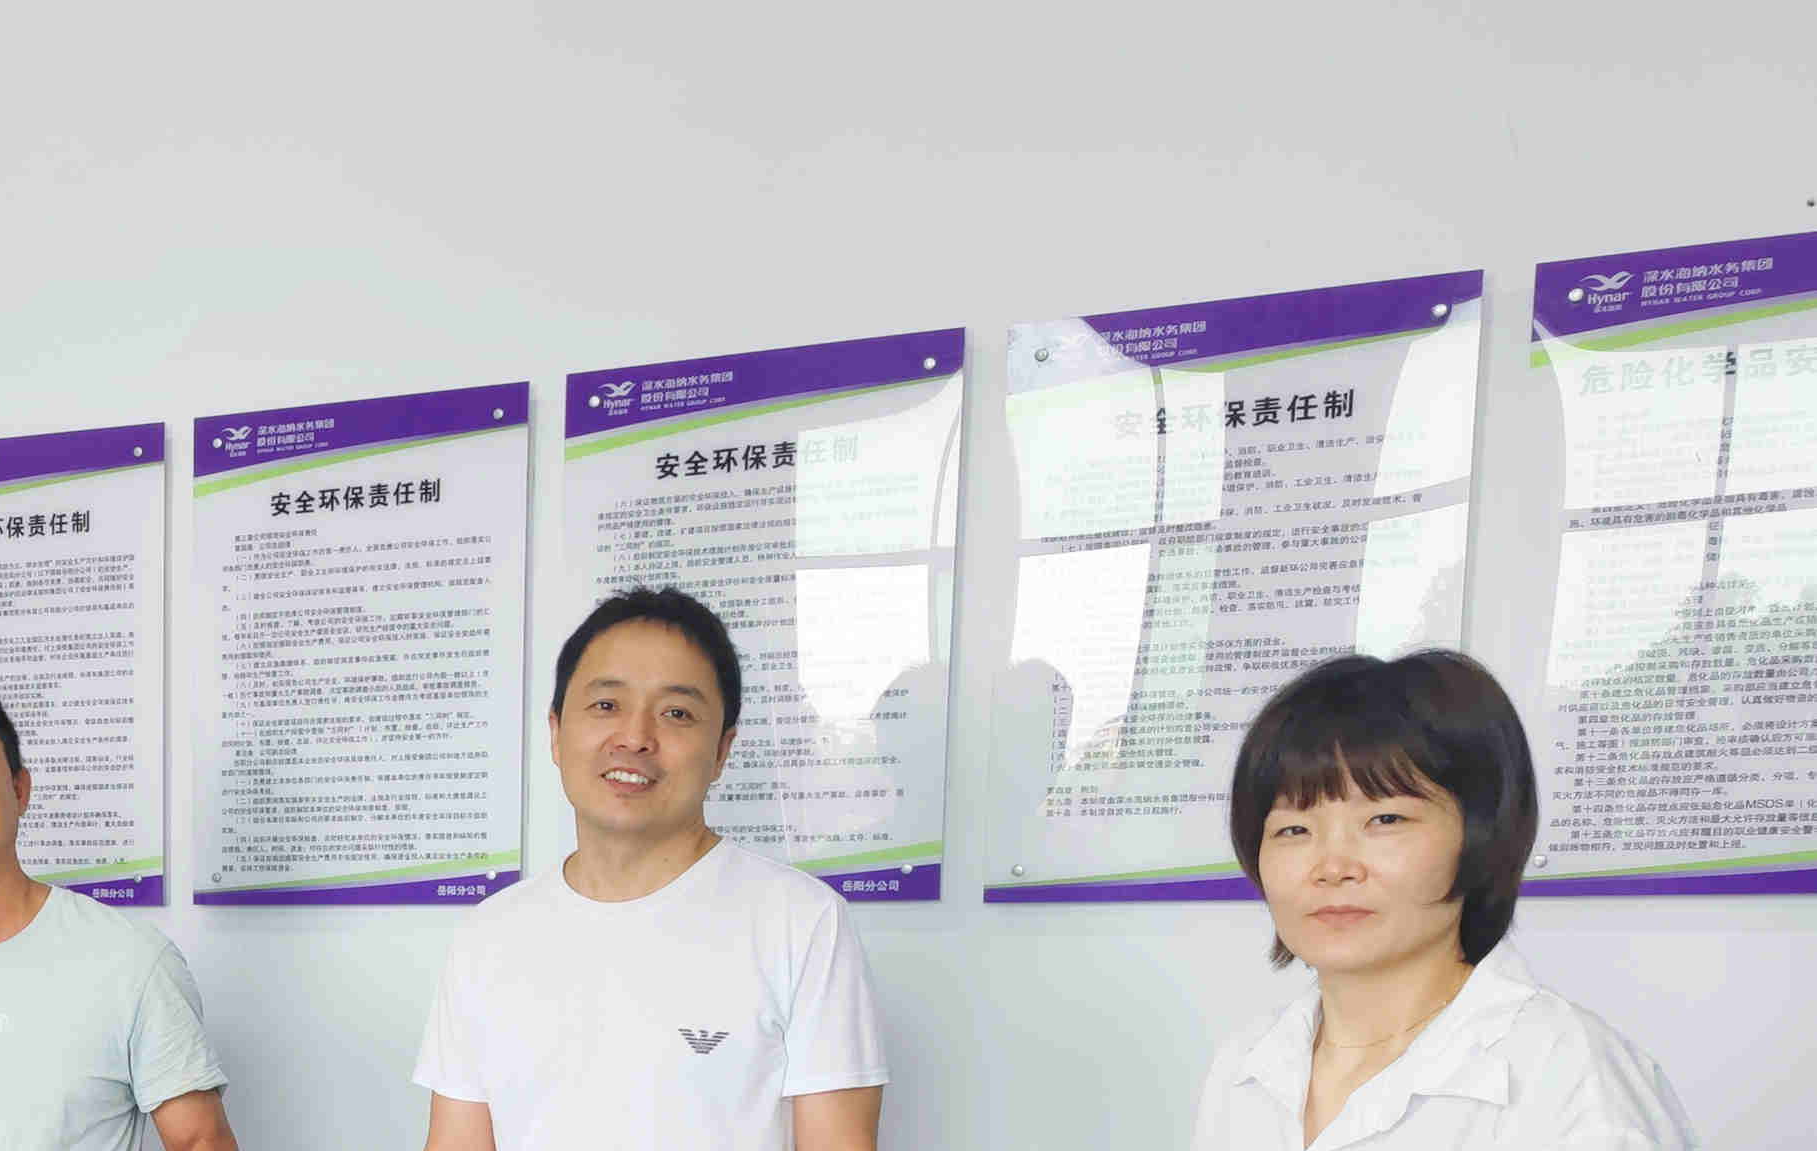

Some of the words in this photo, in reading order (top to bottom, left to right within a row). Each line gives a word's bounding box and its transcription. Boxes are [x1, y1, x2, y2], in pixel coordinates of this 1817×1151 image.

[1643, 257, 1773, 283] 深水海纳水务集团
[1641, 276, 1738, 297] 股份有限公司
[1588, 291, 1631, 305] Hynar
[641, 387, 709, 403] 股份有限公司
[603, 398, 632, 409] Hynar
[271, 478, 440, 517] 安全环保责任制
[437, 884, 486, 896] 岳阳分公司
[842, 880, 899, 893] 岳阳分公司
